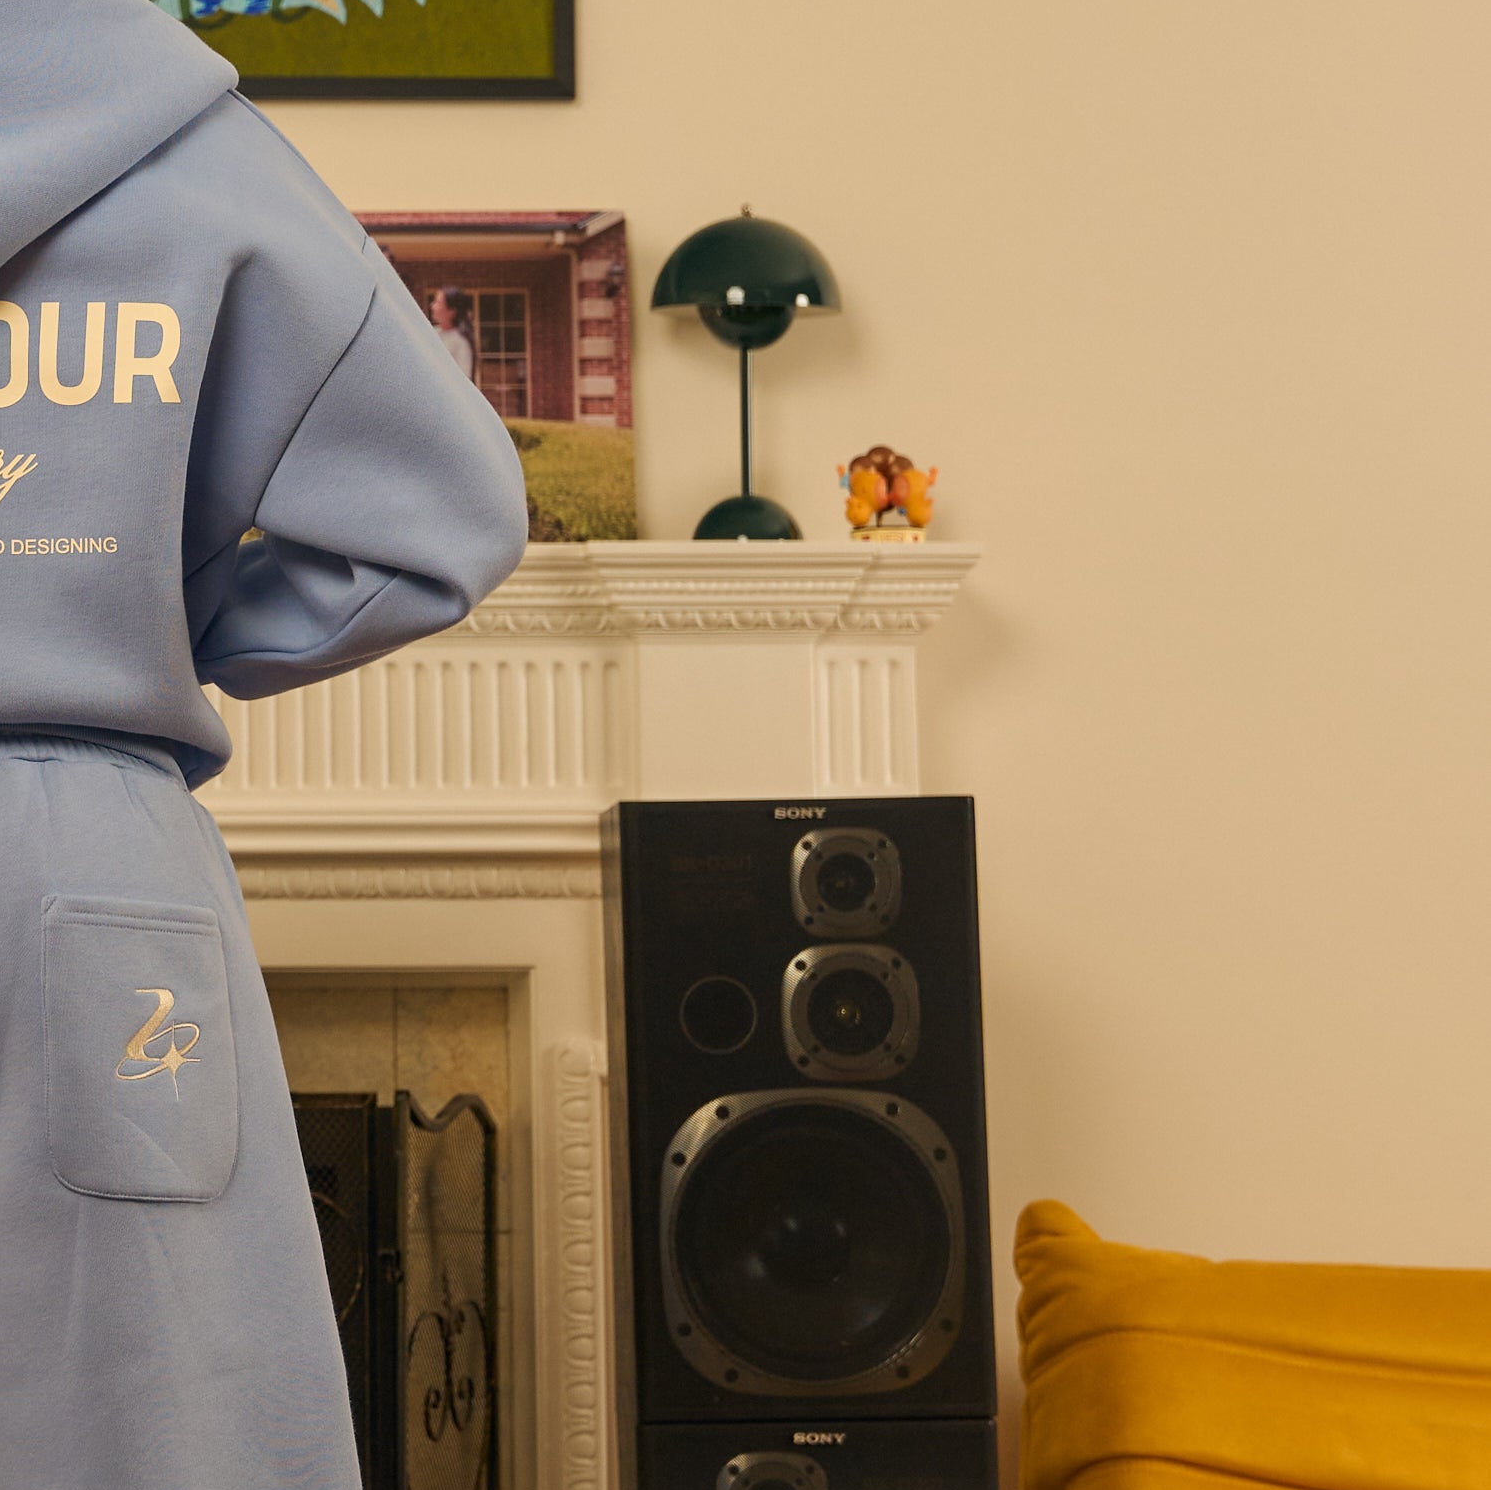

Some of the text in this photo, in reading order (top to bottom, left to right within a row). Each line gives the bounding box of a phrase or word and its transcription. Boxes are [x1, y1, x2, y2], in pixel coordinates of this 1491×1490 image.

[10, 536, 118, 555] DESIGNING
[774, 807, 827, 820] SONY
[793, 1432, 846, 1446] SONY
